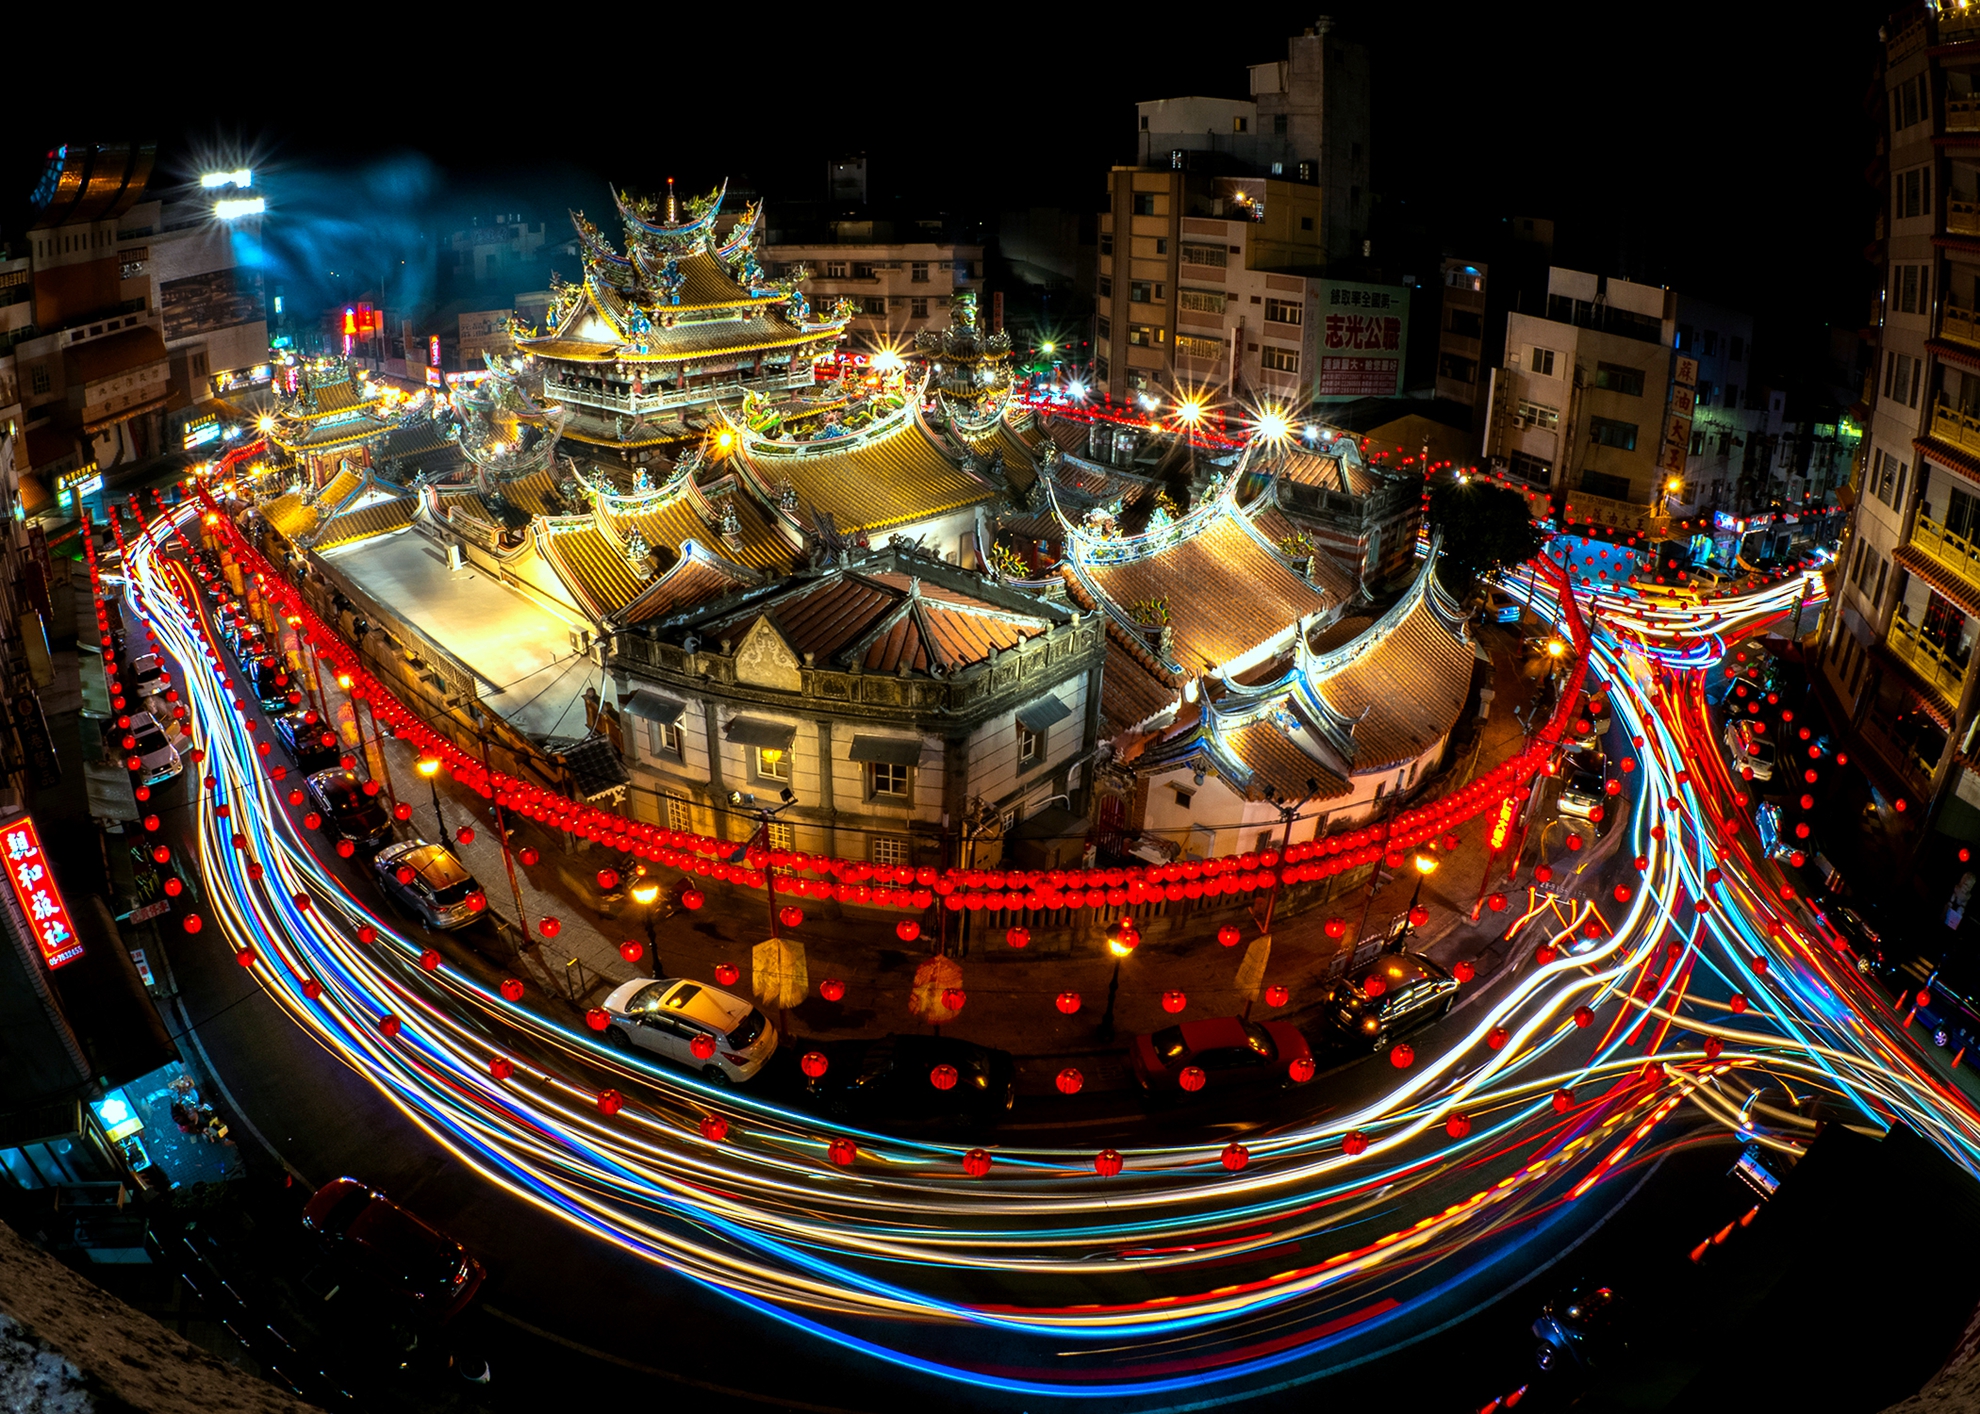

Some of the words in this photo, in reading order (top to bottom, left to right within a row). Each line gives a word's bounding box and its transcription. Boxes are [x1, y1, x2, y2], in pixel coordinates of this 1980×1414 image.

[1325, 314, 1400, 350] 志光公職
[7, 831, 70, 948] 親和旅社
